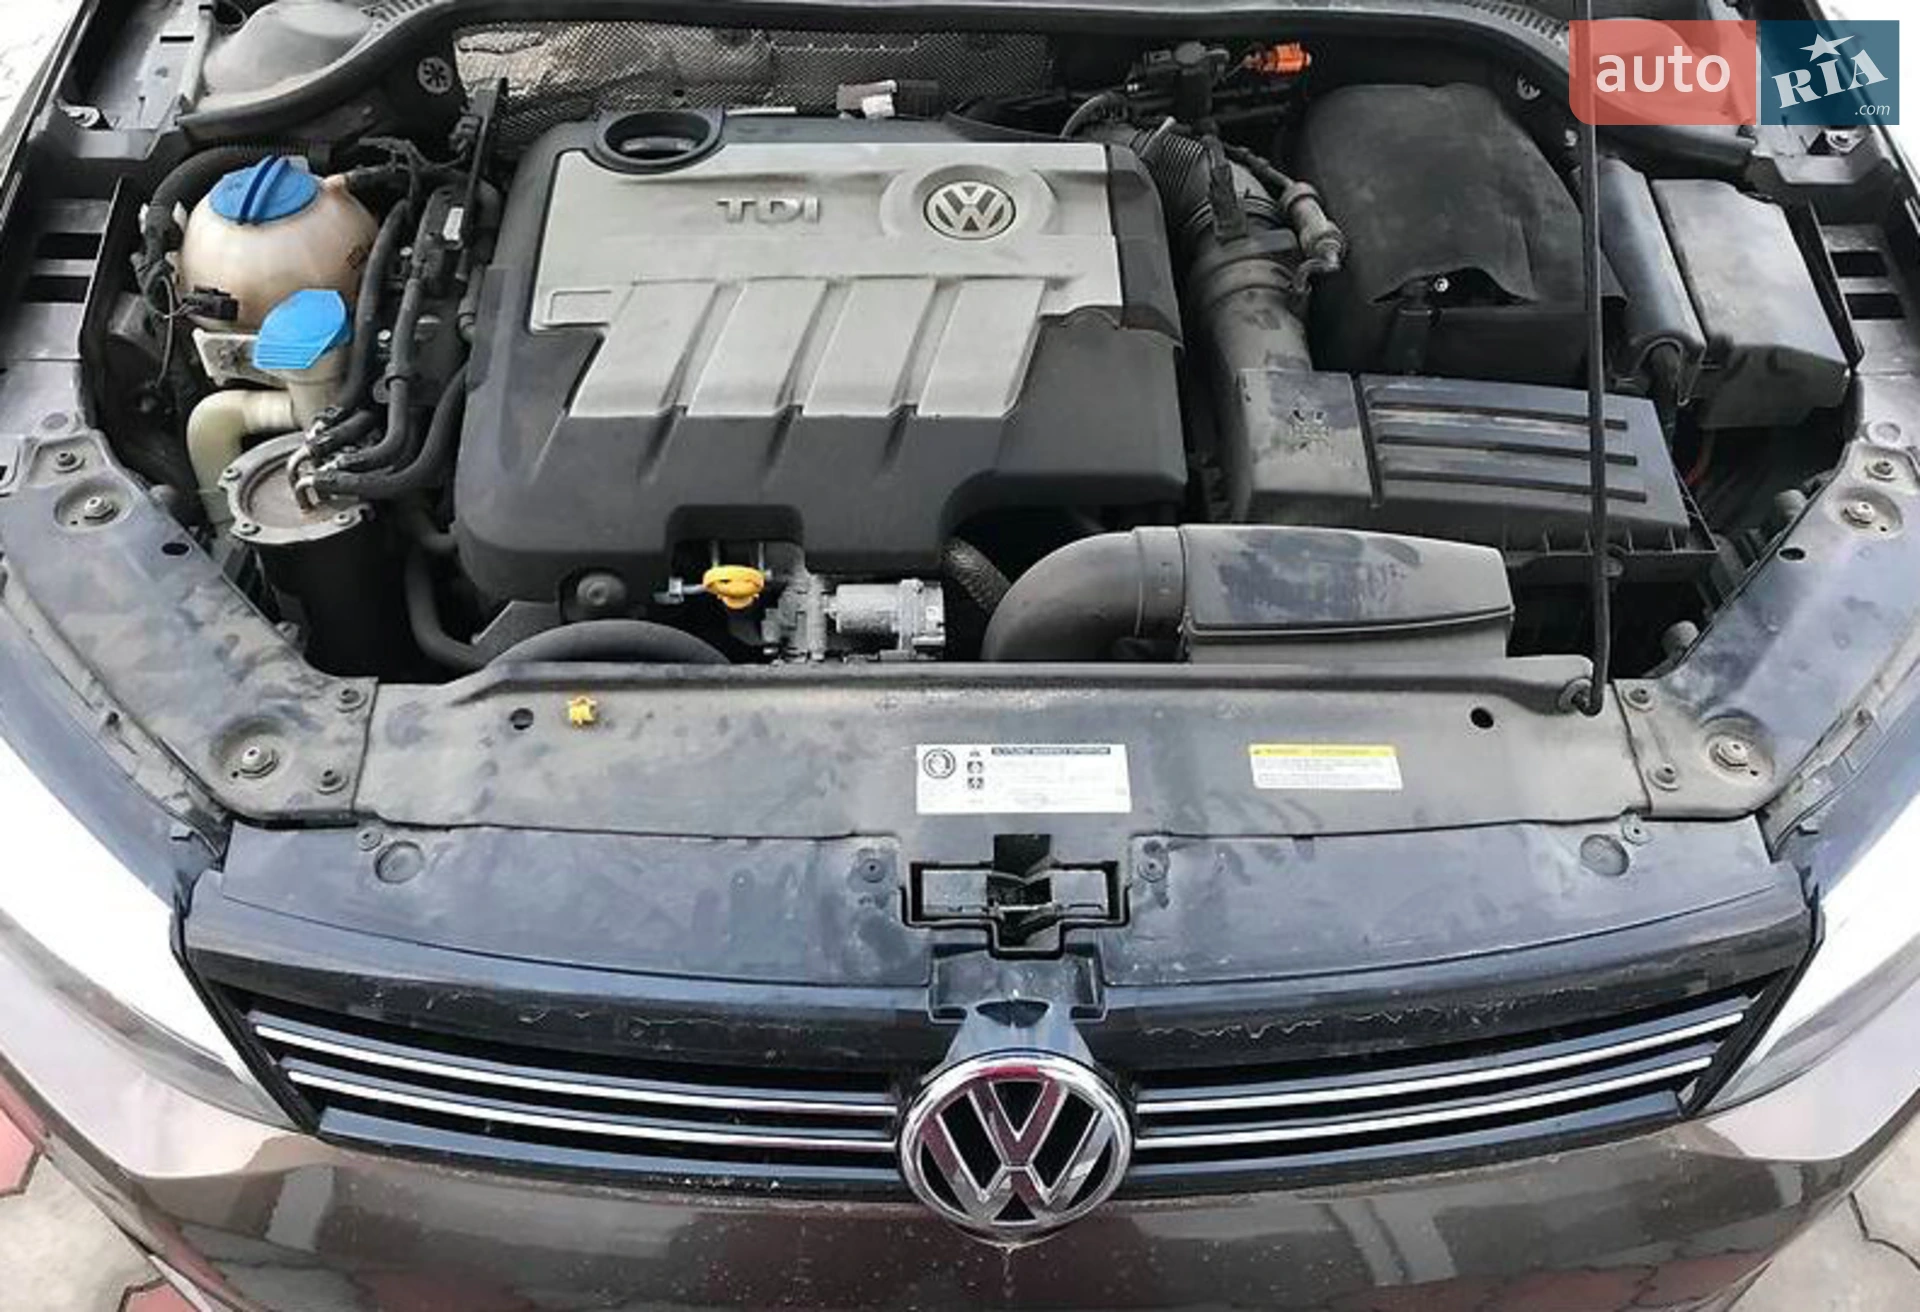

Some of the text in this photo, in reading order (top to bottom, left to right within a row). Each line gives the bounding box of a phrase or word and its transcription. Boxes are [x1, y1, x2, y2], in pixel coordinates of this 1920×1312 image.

[717, 196, 820, 225] TDI
[926, 182, 1014, 239] VW
[914, 1070, 1121, 1226] VW
